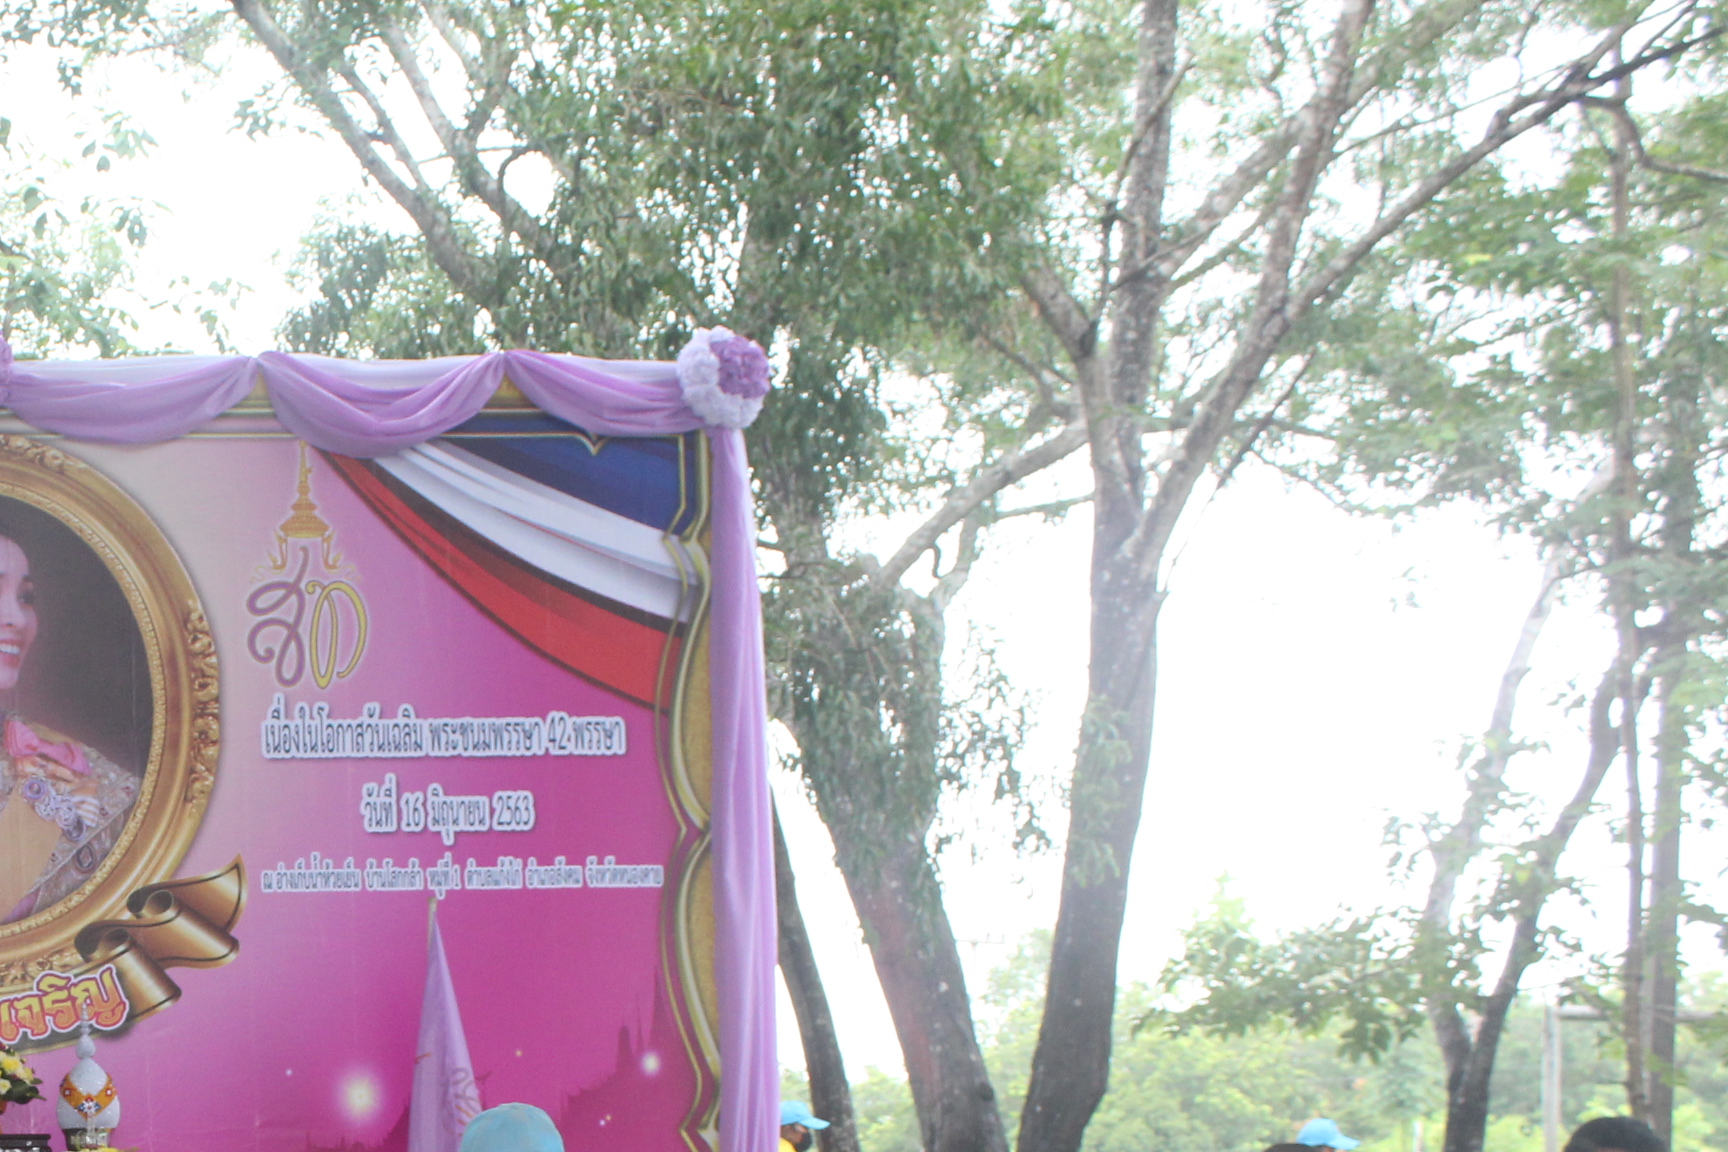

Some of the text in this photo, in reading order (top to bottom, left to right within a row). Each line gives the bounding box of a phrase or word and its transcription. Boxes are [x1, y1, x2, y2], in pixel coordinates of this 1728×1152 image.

[263, 696, 625, 756] เนื่องในโอกาสวันเฉลิม พระชนมพรรษา 42 พรรษา
[363, 776, 534, 844] วันที่ 16 มิถุนายน 2563
